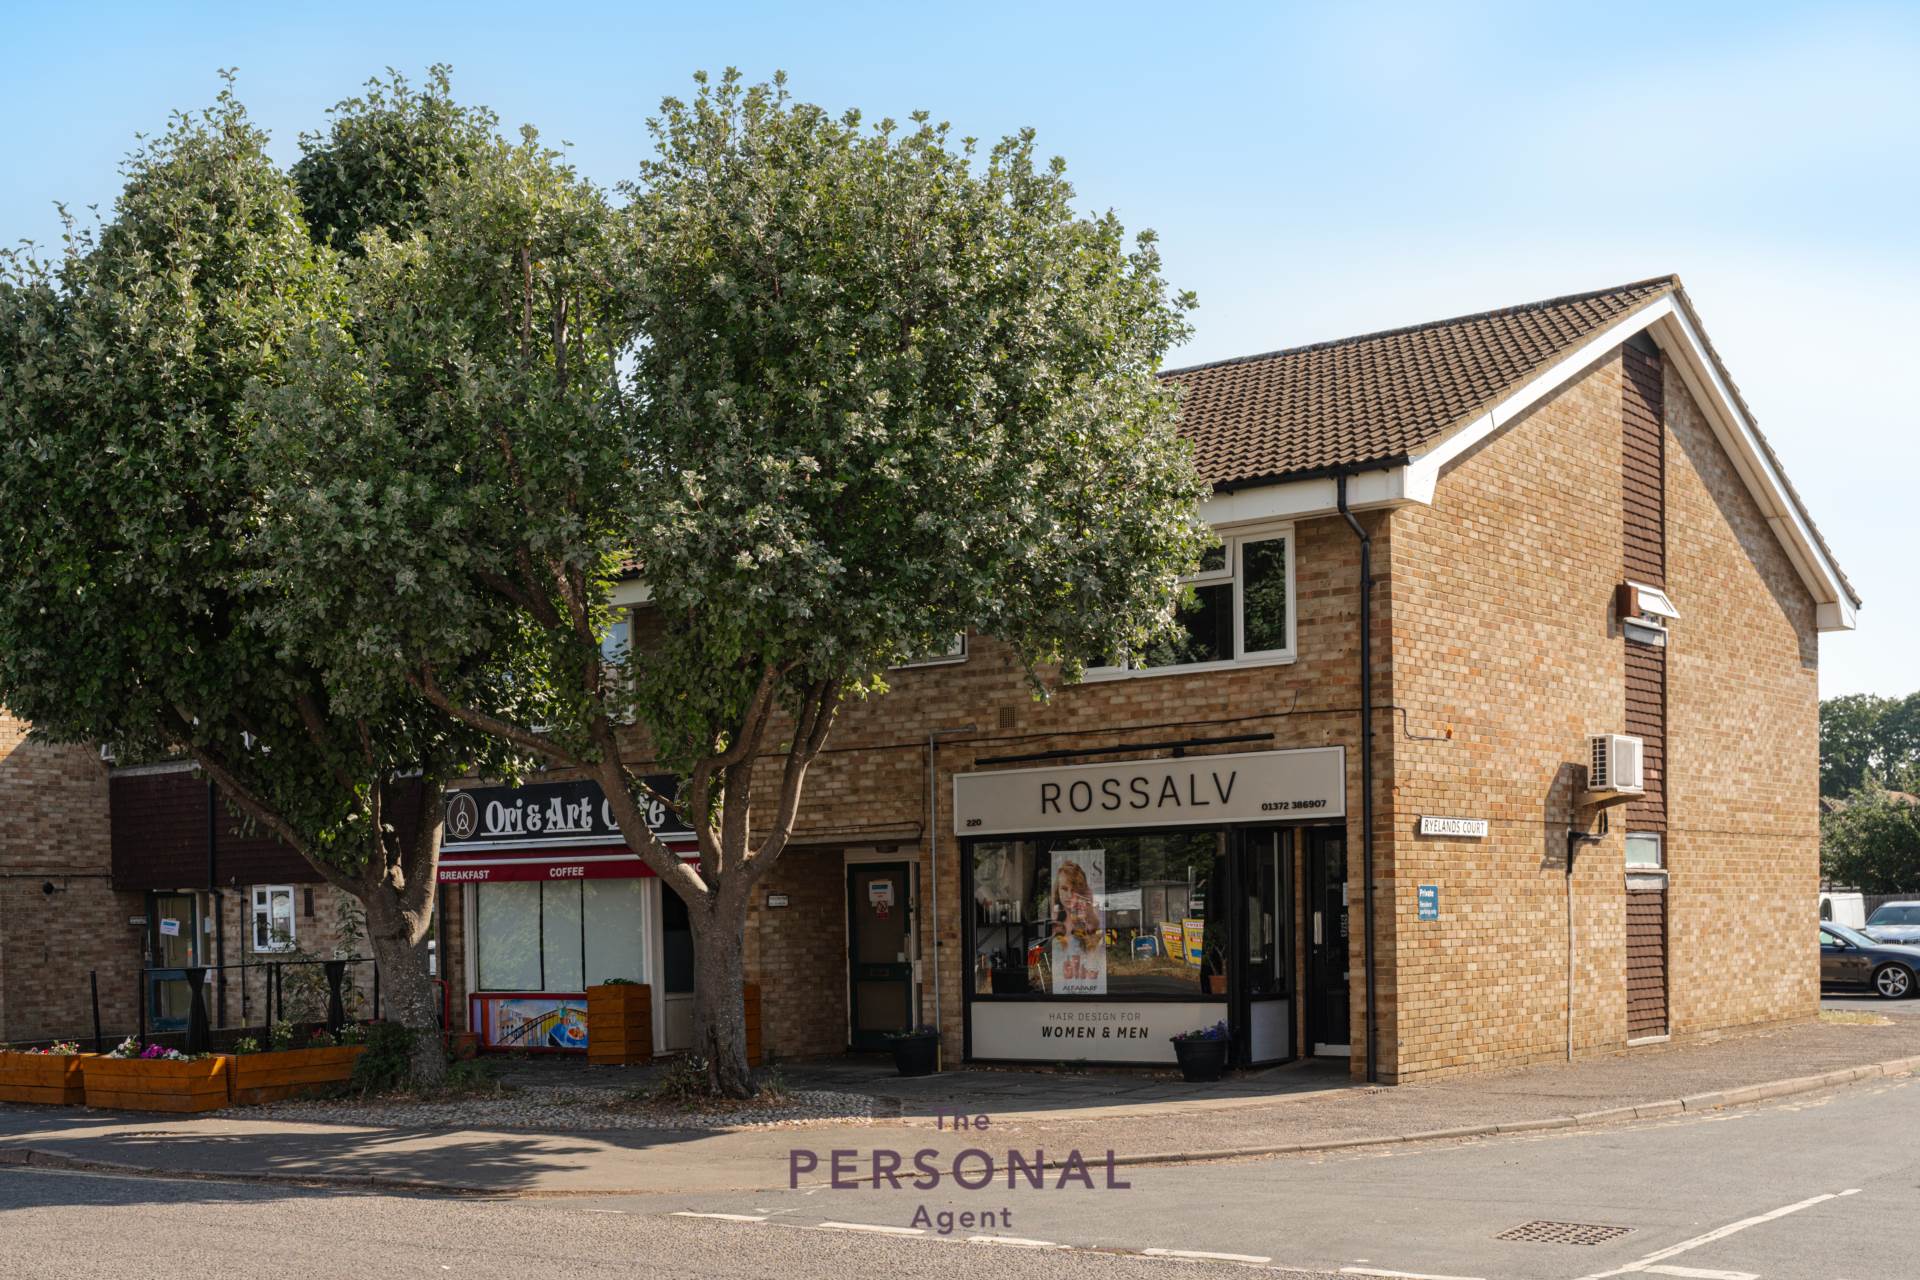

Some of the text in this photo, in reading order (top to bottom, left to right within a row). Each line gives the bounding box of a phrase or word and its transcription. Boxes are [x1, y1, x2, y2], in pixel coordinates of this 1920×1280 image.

[1041, 771, 1238, 814] ROSSALV
[1261, 801, 1289, 811] 01372
[966, 818, 982, 827] 220
[1424, 819, 1484, 834] RYELANDS COURT
[440, 866, 584, 880] BREAKFAST COFFEE
[1049, 1012, 1141, 1021] HAIR DESIGN FOR
[1042, 1026, 1149, 1039] WOMEN & MEN
